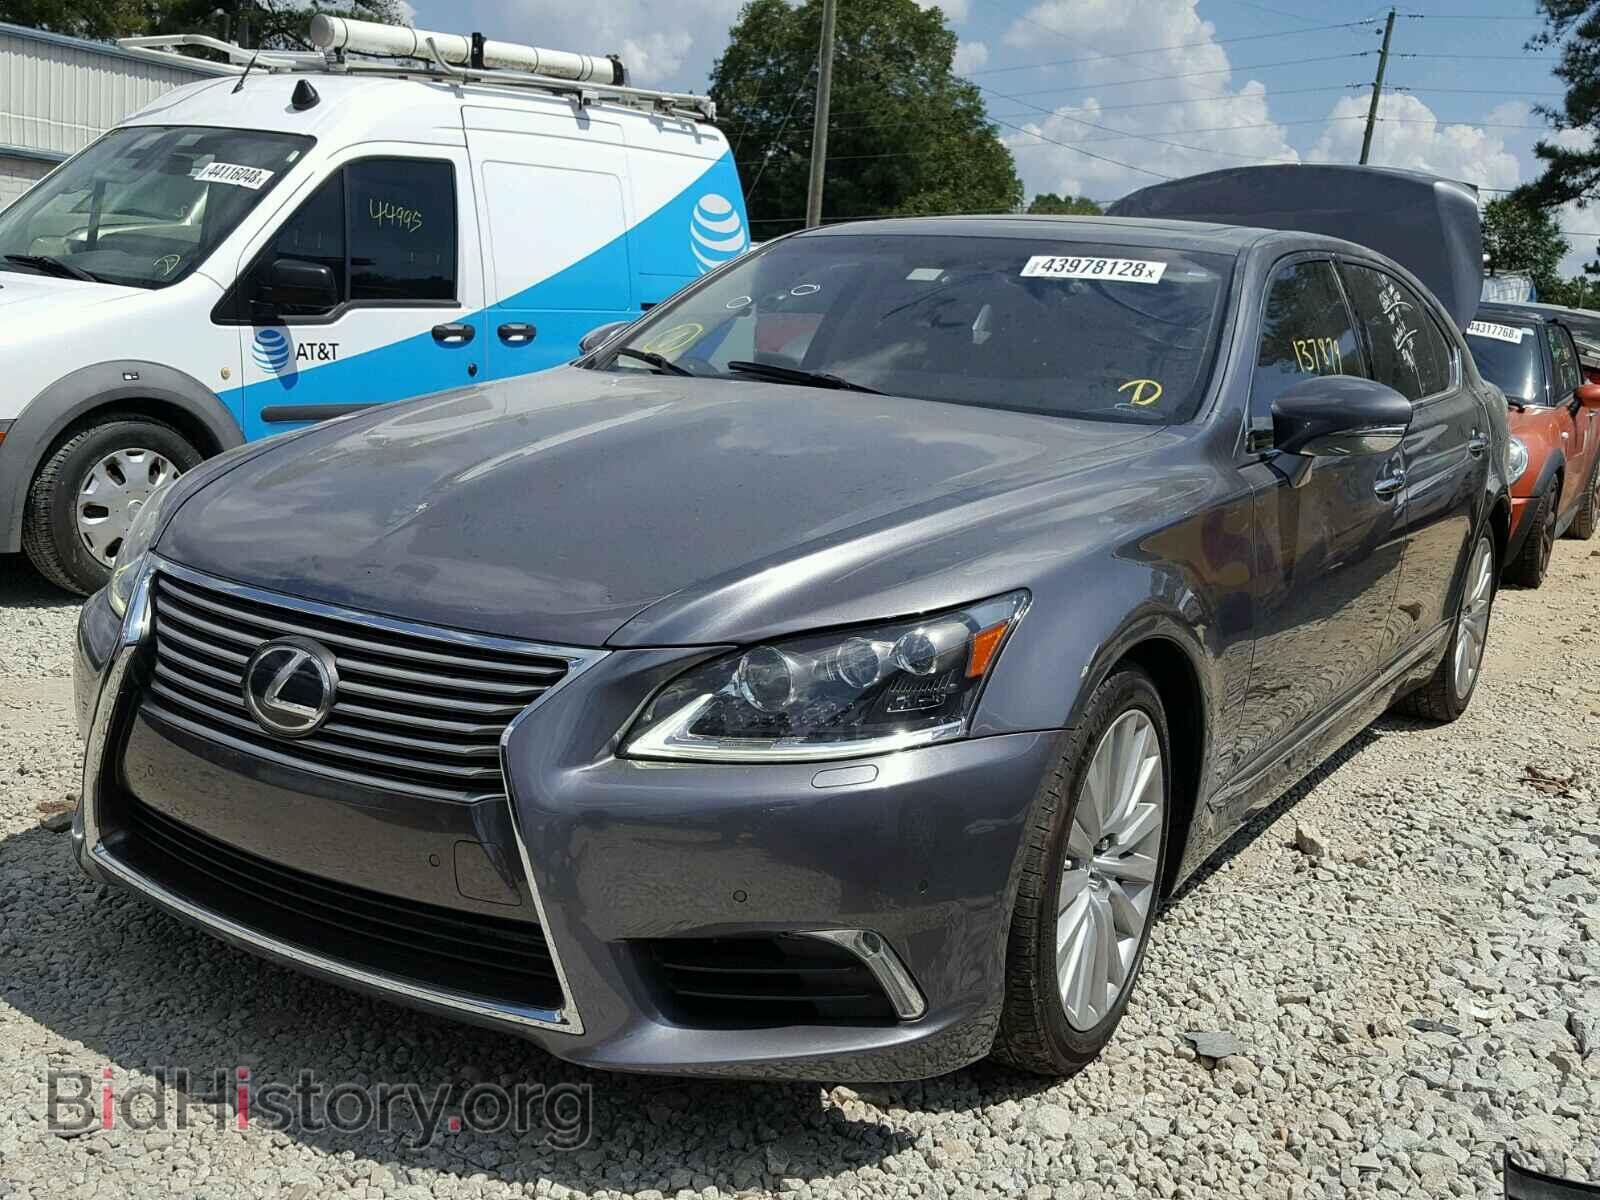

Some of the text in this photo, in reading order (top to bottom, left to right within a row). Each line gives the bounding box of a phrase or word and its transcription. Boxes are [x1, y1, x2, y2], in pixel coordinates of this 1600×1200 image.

[369, 198, 423, 233] 44995
[295, 342, 340, 361] AT&T
[1117, 379, 1163, 406] D
